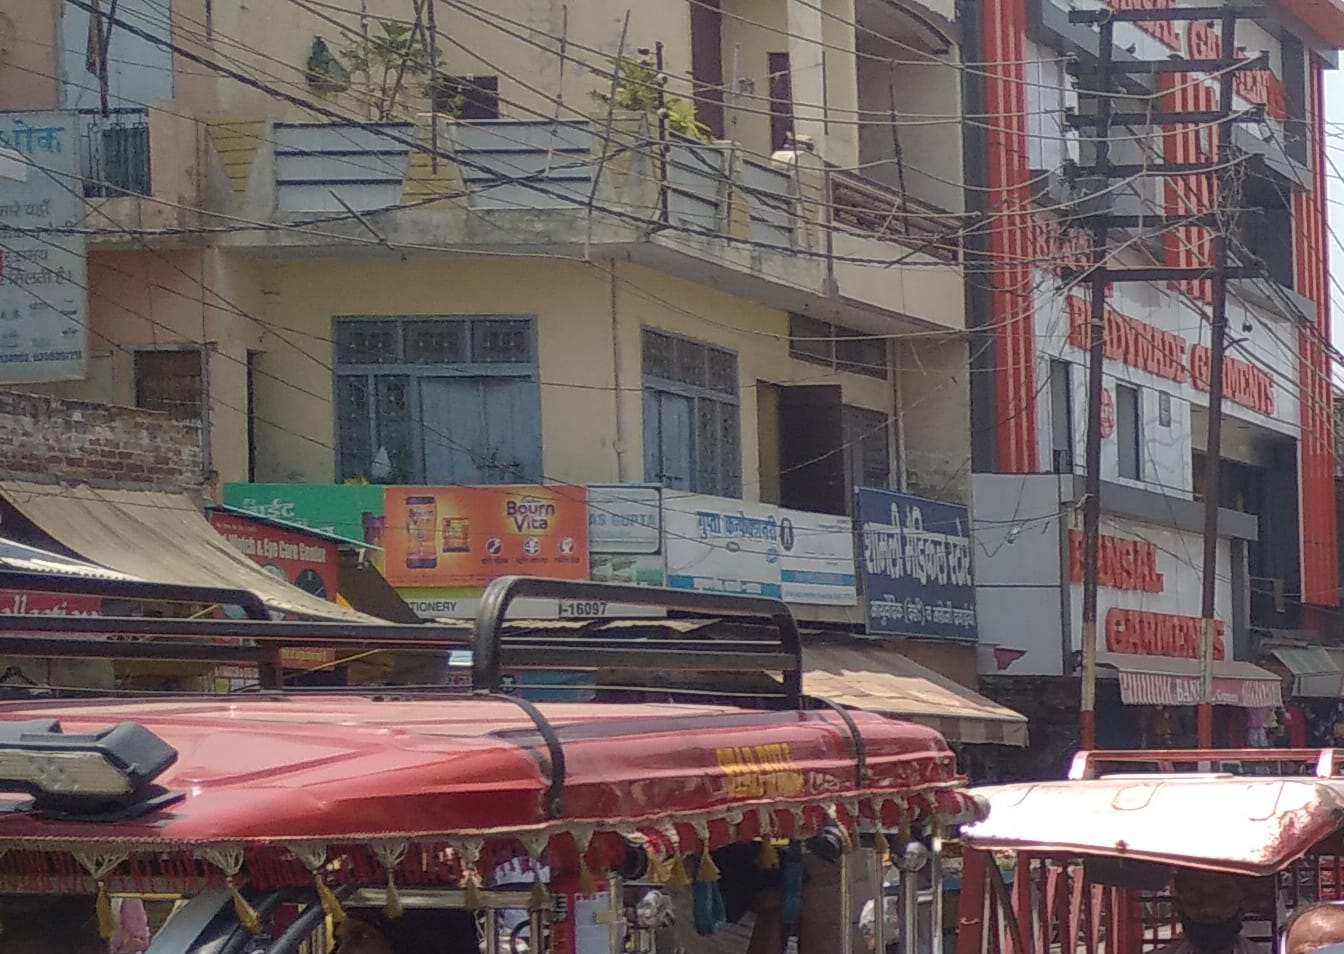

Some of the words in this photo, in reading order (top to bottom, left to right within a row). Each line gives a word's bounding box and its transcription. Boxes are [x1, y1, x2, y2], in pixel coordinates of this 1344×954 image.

[1190, 343, 1274, 416] GAMENTS
[507, 501, 555, 516] Bourn
[514, 515, 548, 532] Vita
[409, 602, 457, 613] TIONERY
[1105, 607, 1224, 661] GARMENS
